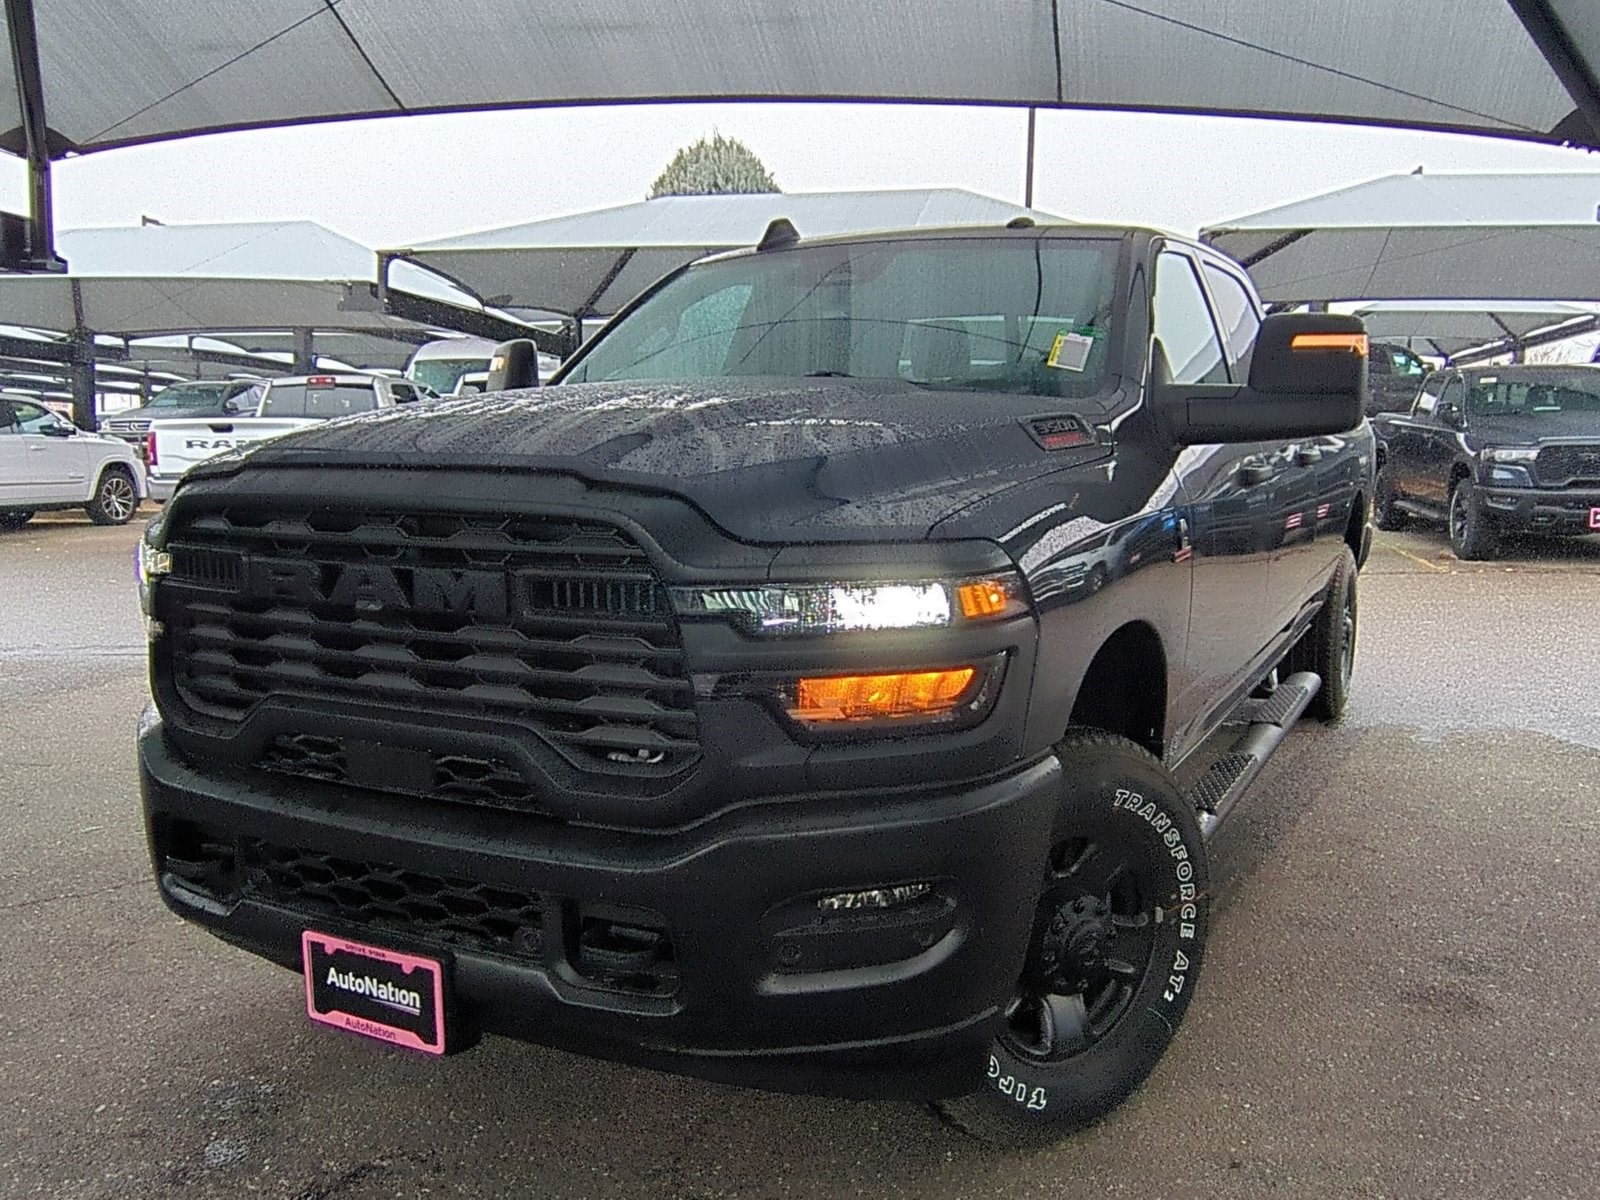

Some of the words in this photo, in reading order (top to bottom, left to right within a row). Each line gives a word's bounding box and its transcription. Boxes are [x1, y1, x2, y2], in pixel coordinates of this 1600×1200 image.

[250, 559, 507, 616] RAM
[1114, 788, 1197, 939] TRANSFORCE
[326, 966, 420, 1008] AutoNation
[344, 1017, 397, 1040] AutoNation
